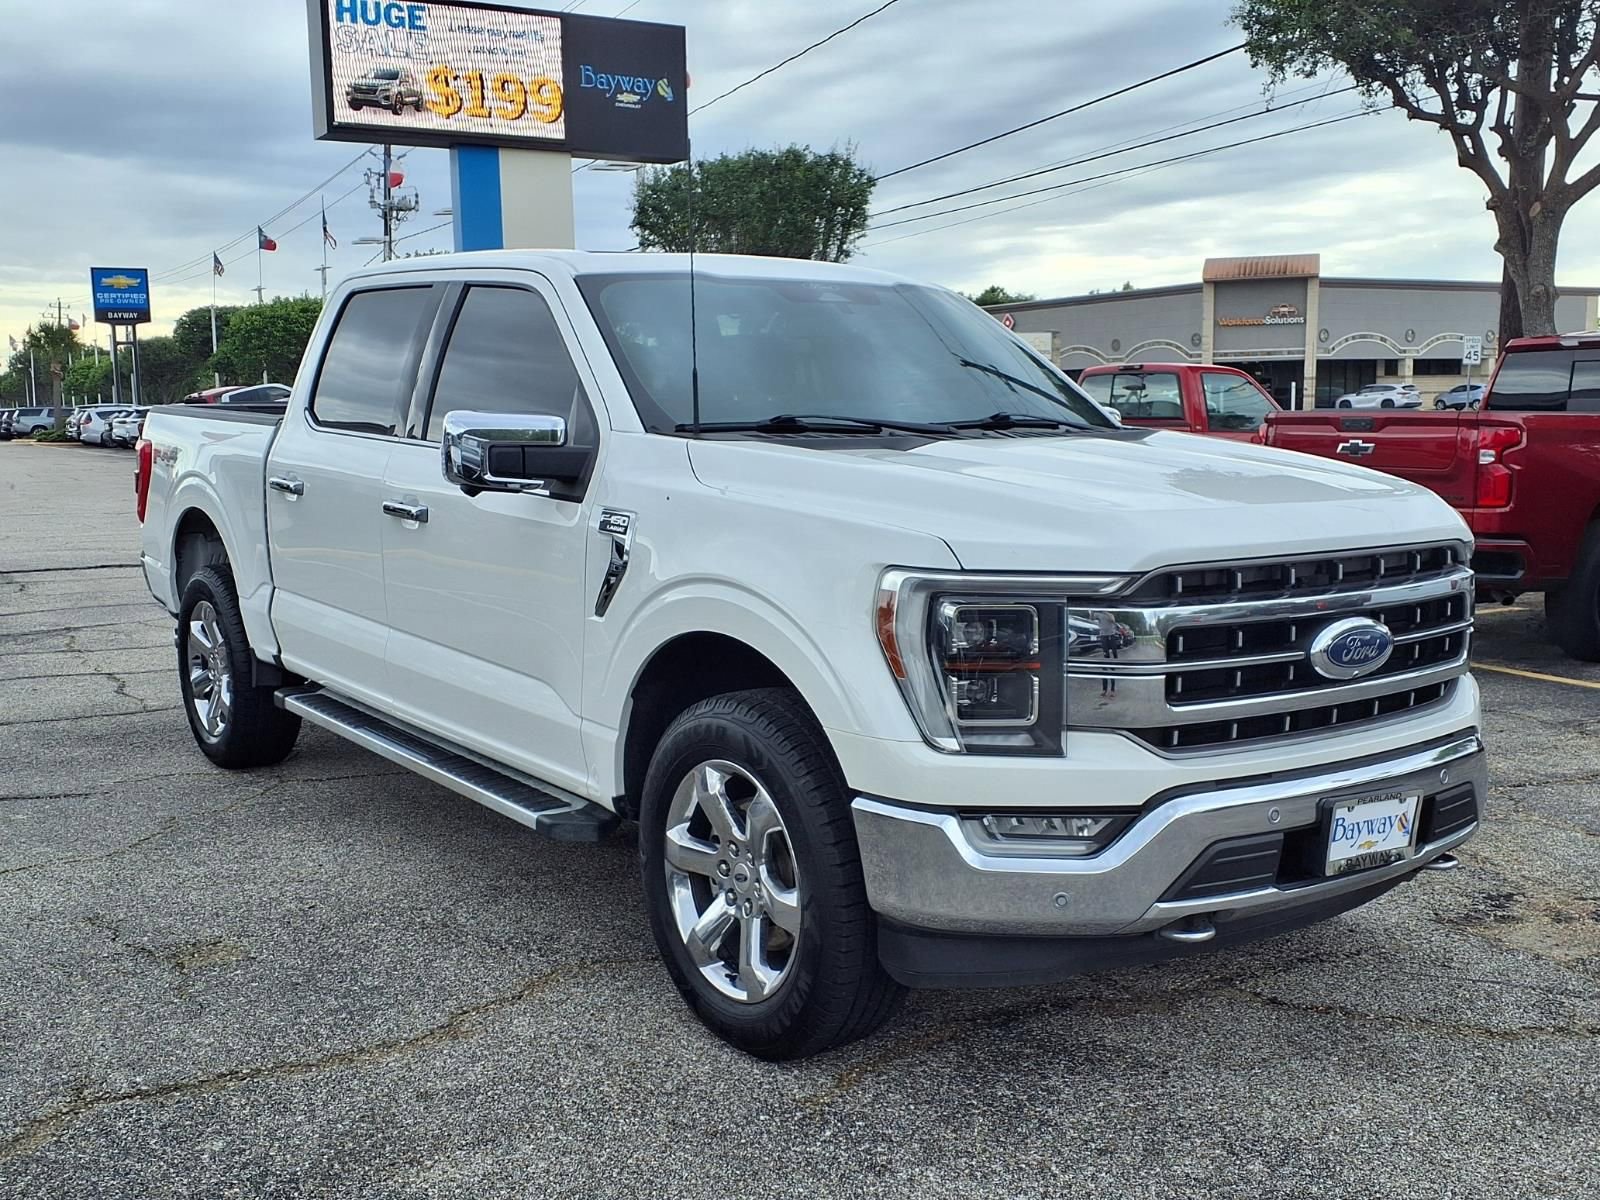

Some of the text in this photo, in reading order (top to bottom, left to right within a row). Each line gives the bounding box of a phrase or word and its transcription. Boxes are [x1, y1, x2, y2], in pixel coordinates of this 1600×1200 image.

[336, 0, 427, 30] HUGE
[336, 25, 429, 60] SALE
[424, 64, 564, 124] $199
[579, 64, 655, 101] Bayway
[107, 311, 138, 319] BAYWAY
[1464, 350, 1480, 362] 45
[1342, 634, 1380, 663] Ford
[1357, 792, 1402, 805] PEARLAND
[1331, 814, 1398, 849] Bayway
[1345, 849, 1392, 871] BAYWAY
